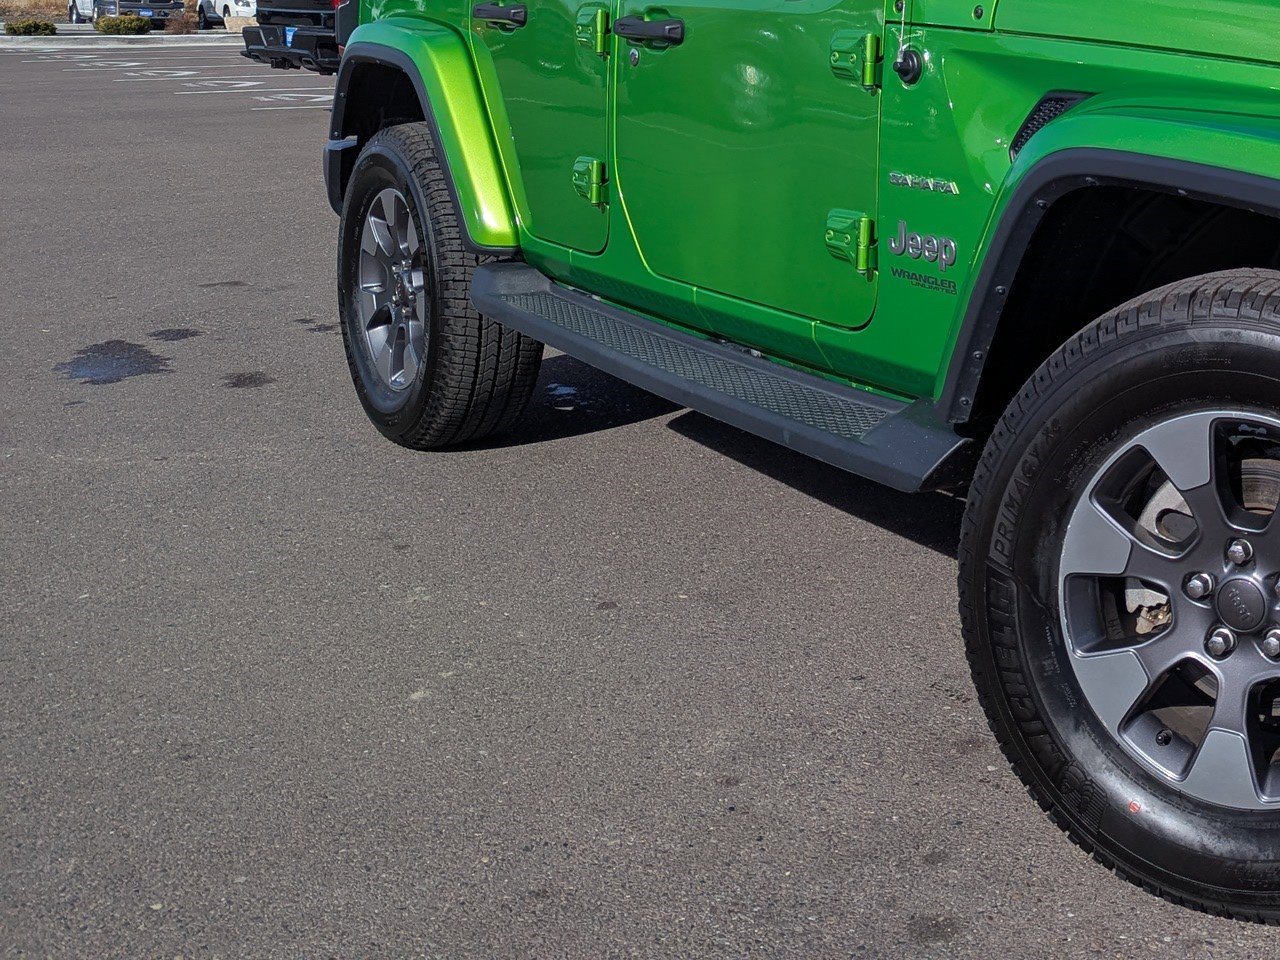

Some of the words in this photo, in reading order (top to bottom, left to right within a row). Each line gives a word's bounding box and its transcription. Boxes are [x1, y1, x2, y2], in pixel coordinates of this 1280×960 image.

[890, 172, 959, 195] SAHARA
[888, 220, 956, 271] Jeep
[890, 267, 957, 290] WRANGLER
[911, 280, 957, 295] UNLIMITED
